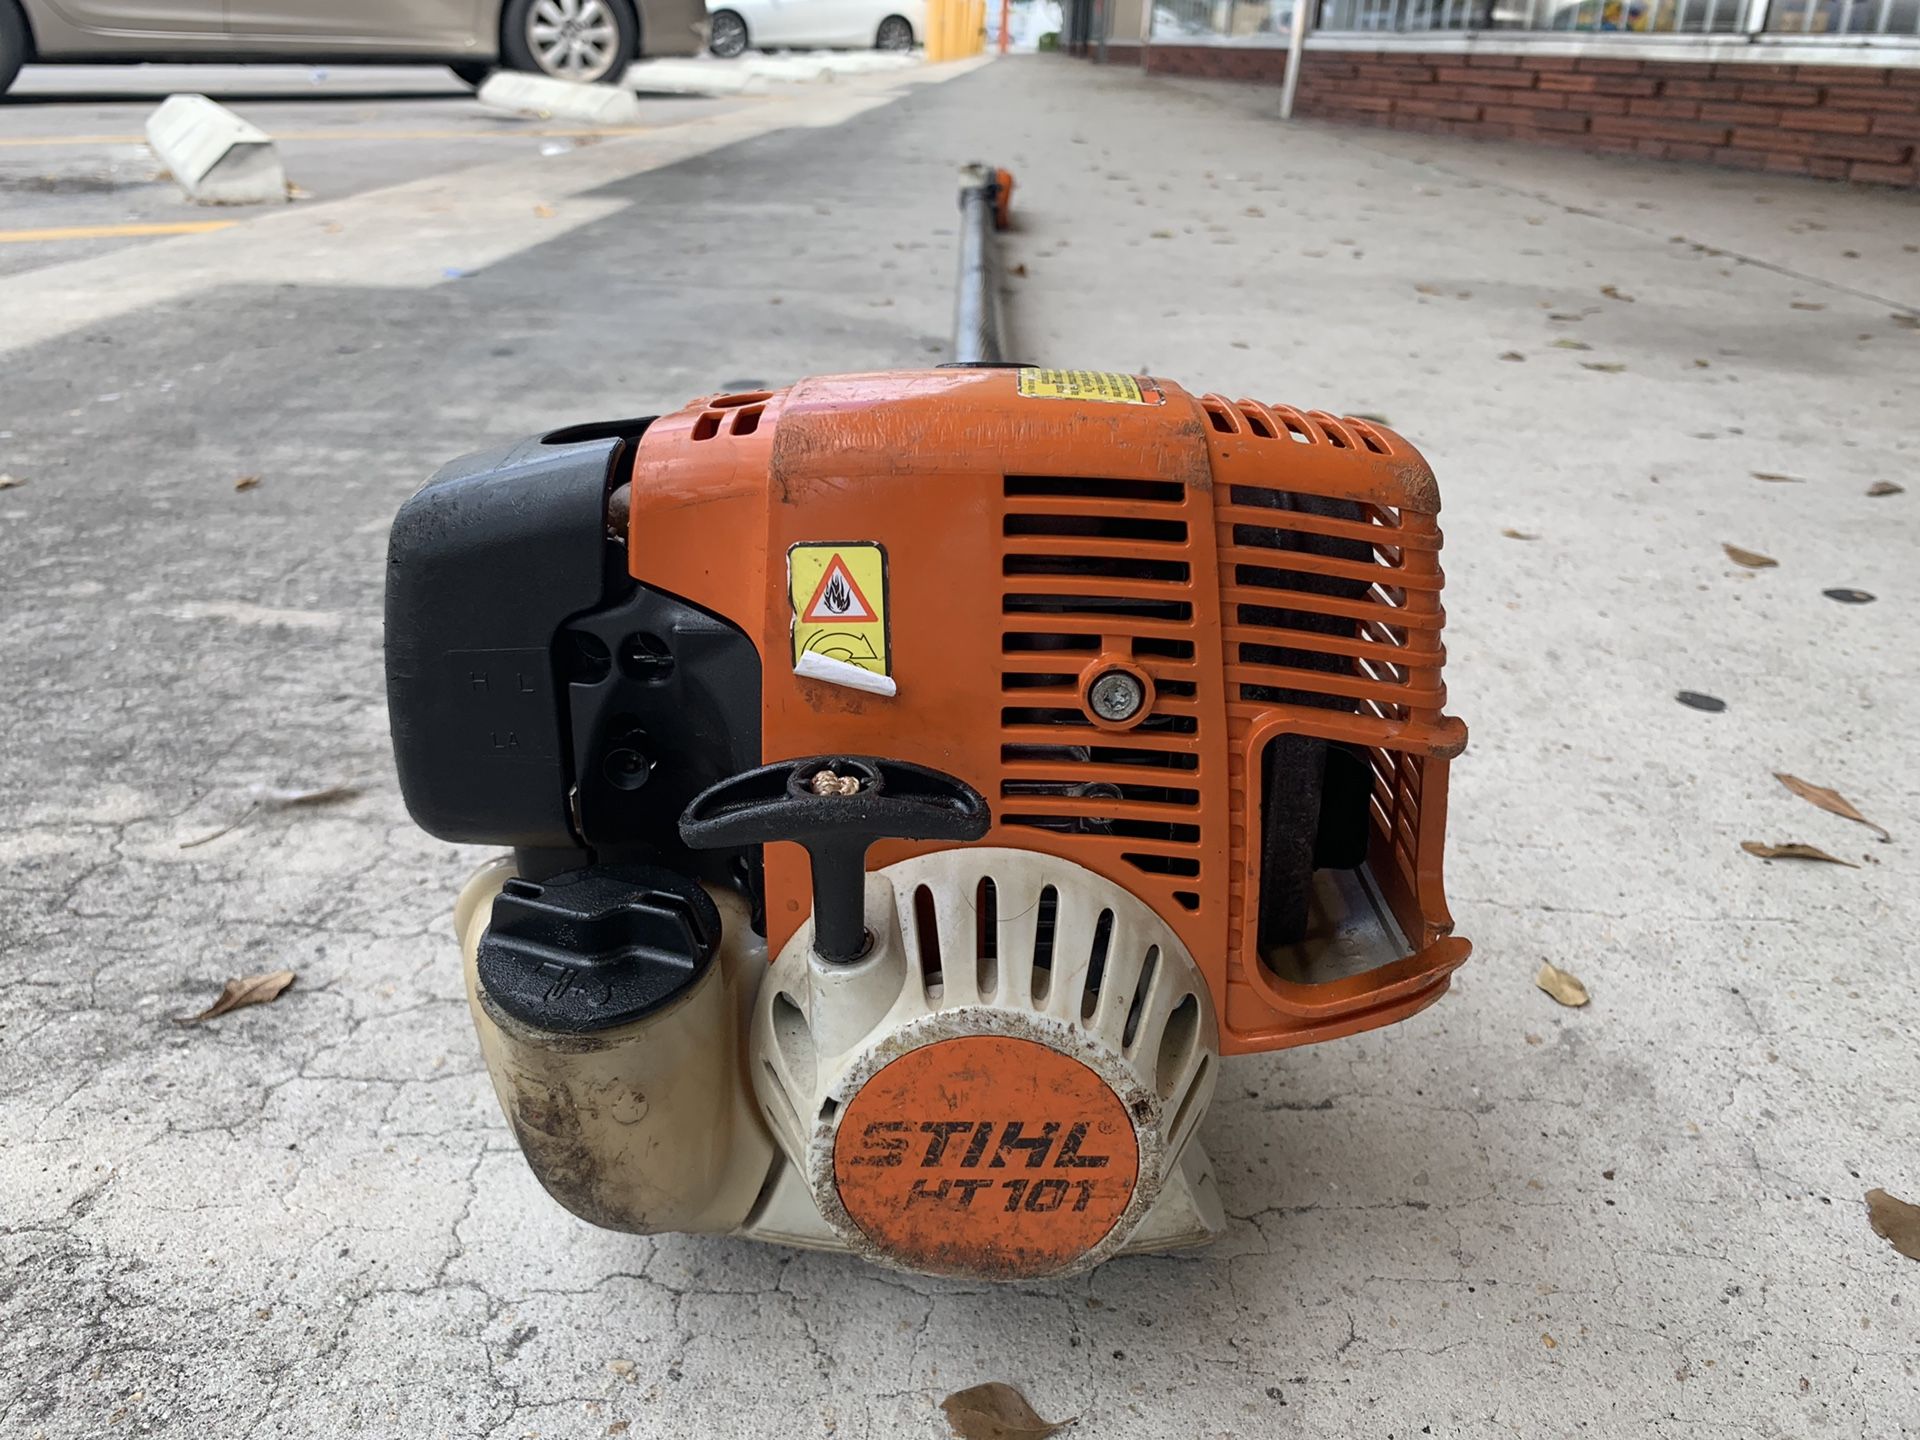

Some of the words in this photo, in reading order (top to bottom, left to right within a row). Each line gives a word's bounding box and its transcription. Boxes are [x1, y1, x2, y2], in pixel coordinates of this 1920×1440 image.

[850, 1121, 1109, 1168] STIHL
[904, 1178, 993, 1212] HT
[1002, 1178, 1098, 1212] 101
